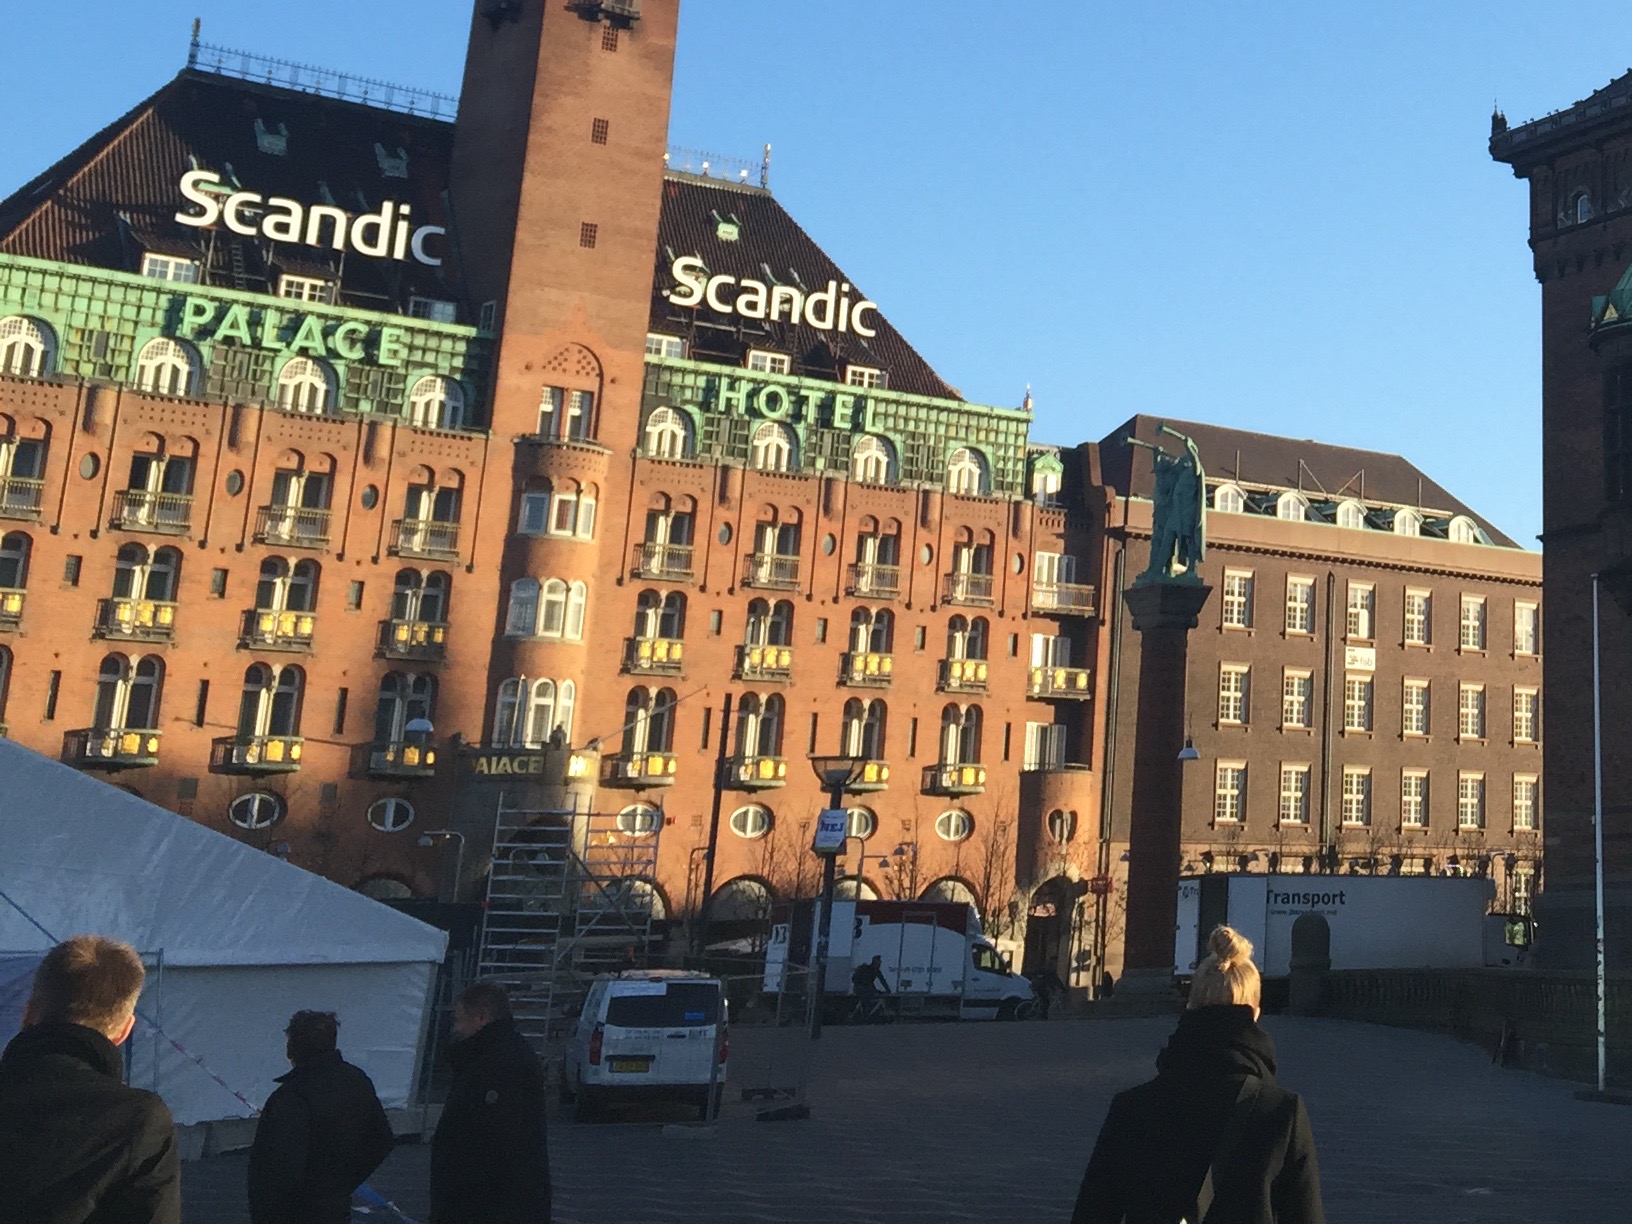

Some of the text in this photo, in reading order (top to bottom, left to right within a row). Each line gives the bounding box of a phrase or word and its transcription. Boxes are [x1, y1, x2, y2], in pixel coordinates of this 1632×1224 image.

[174, 169, 446, 266] Scandic
[668, 255, 878, 338] Scandic
[181, 295, 405, 367] PALACE
[717, 376, 885, 433] HOTEL
[471, 756, 545, 775] ALACE
[1266, 889, 1346, 908] Transport
